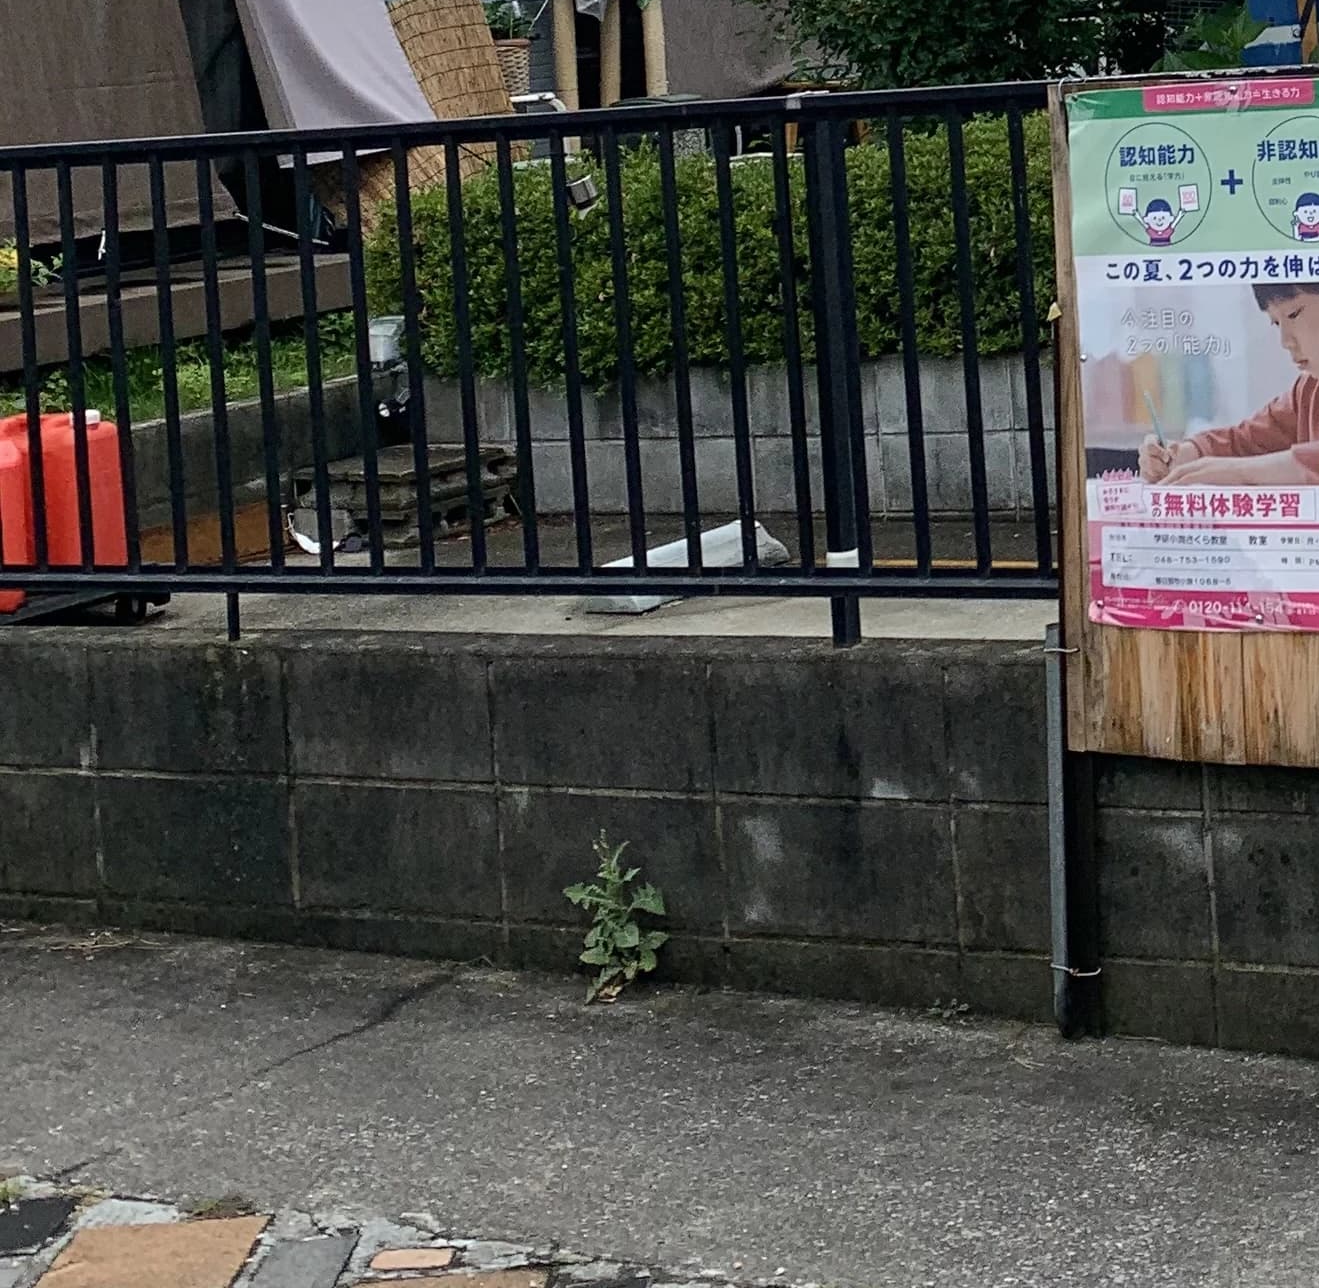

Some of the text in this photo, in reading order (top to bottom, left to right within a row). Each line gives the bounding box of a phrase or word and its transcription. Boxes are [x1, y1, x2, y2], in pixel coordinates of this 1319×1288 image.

[1119, 144, 1195, 167] 認知能力
[1121, 308, 1193, 329] 今注目の
[1164, 491, 1300, 518] 無料体験学習
